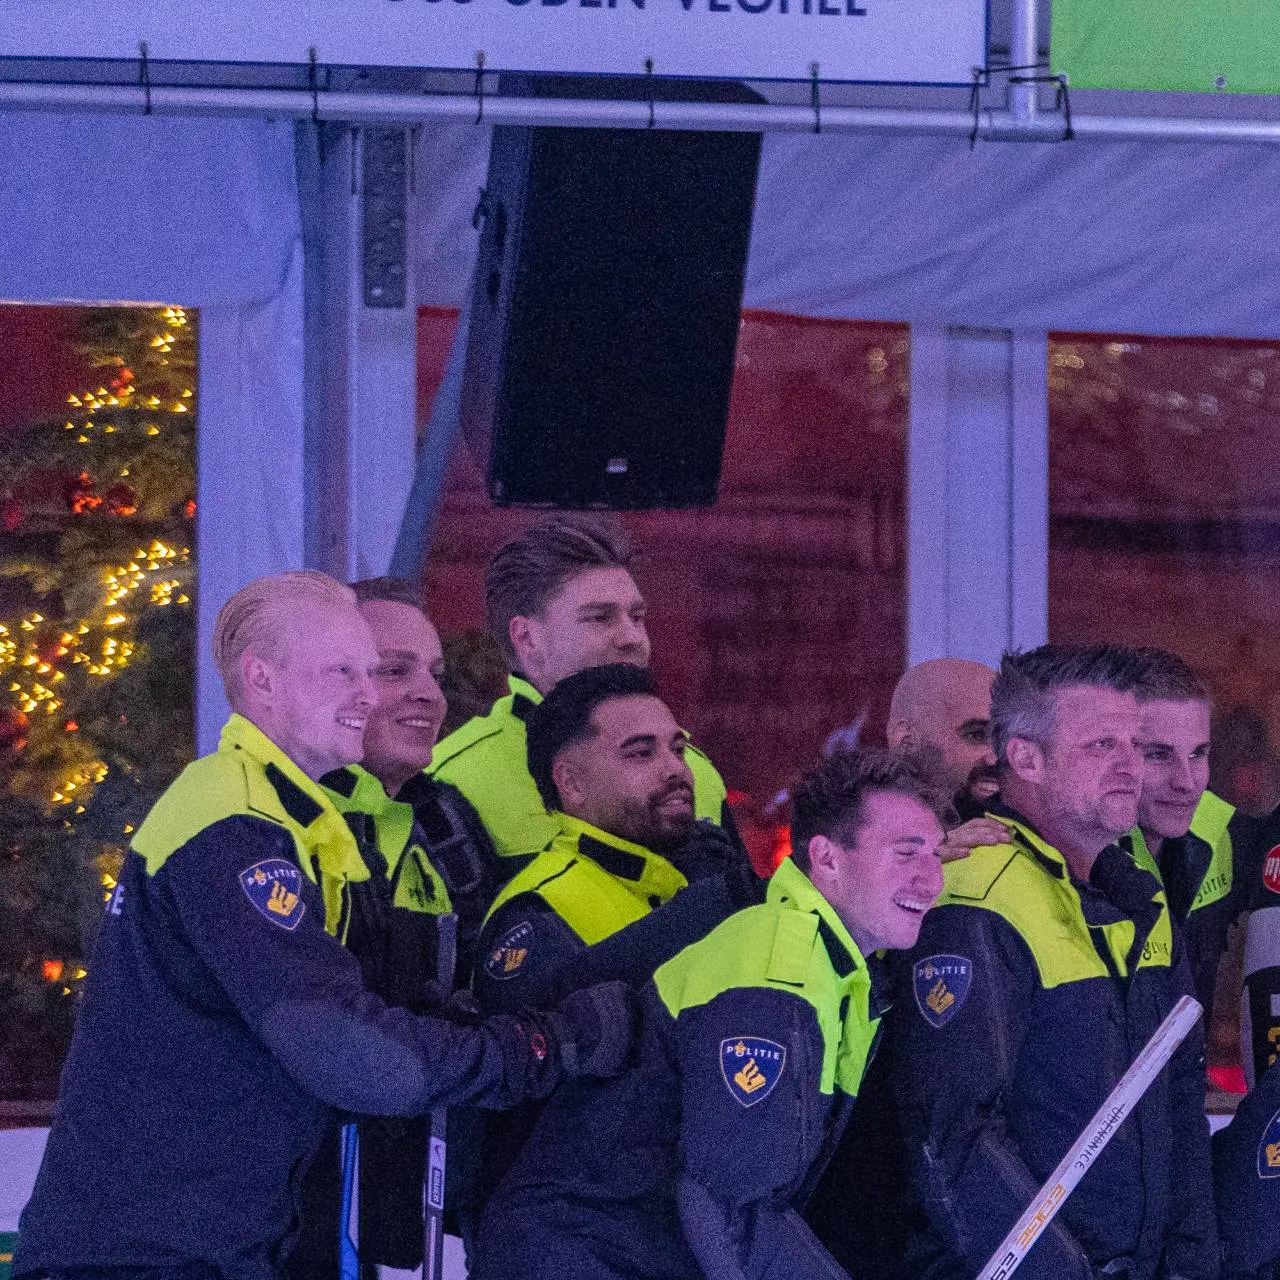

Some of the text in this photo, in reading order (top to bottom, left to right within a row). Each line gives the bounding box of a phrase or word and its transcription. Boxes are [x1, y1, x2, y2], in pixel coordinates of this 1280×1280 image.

[247, 868, 300, 886] POLITIE
[1196, 873, 1227, 903] OLITIE
[724, 1040, 780, 1061] POLITIE
